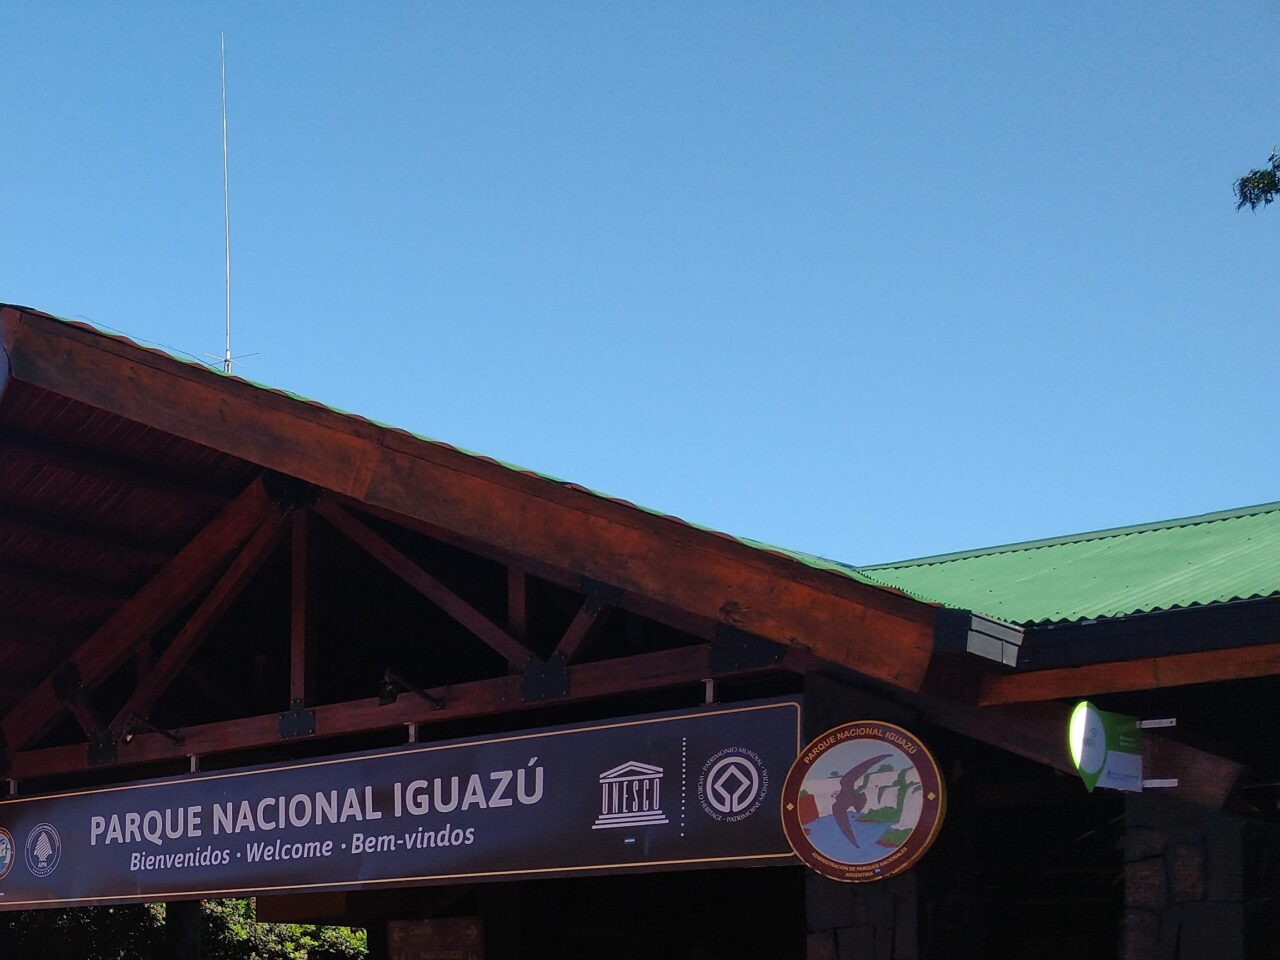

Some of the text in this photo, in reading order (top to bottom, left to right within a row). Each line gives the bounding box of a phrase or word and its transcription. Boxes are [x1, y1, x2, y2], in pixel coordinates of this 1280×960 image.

[702, 746, 764, 771] PATRIMONIO MUNDIAL
[804, 727, 918, 764] PARQUE NACIONAL IGUAZÚ
[89, 805, 202, 847] PARQUE
[213, 785, 383, 836] NACIONAL
[394, 756, 545, 818] IGUAZÚ
[602, 778, 660, 815] UNESCO
[130, 822, 476, 872] Bienvenidos Welcome Bem-vindos
